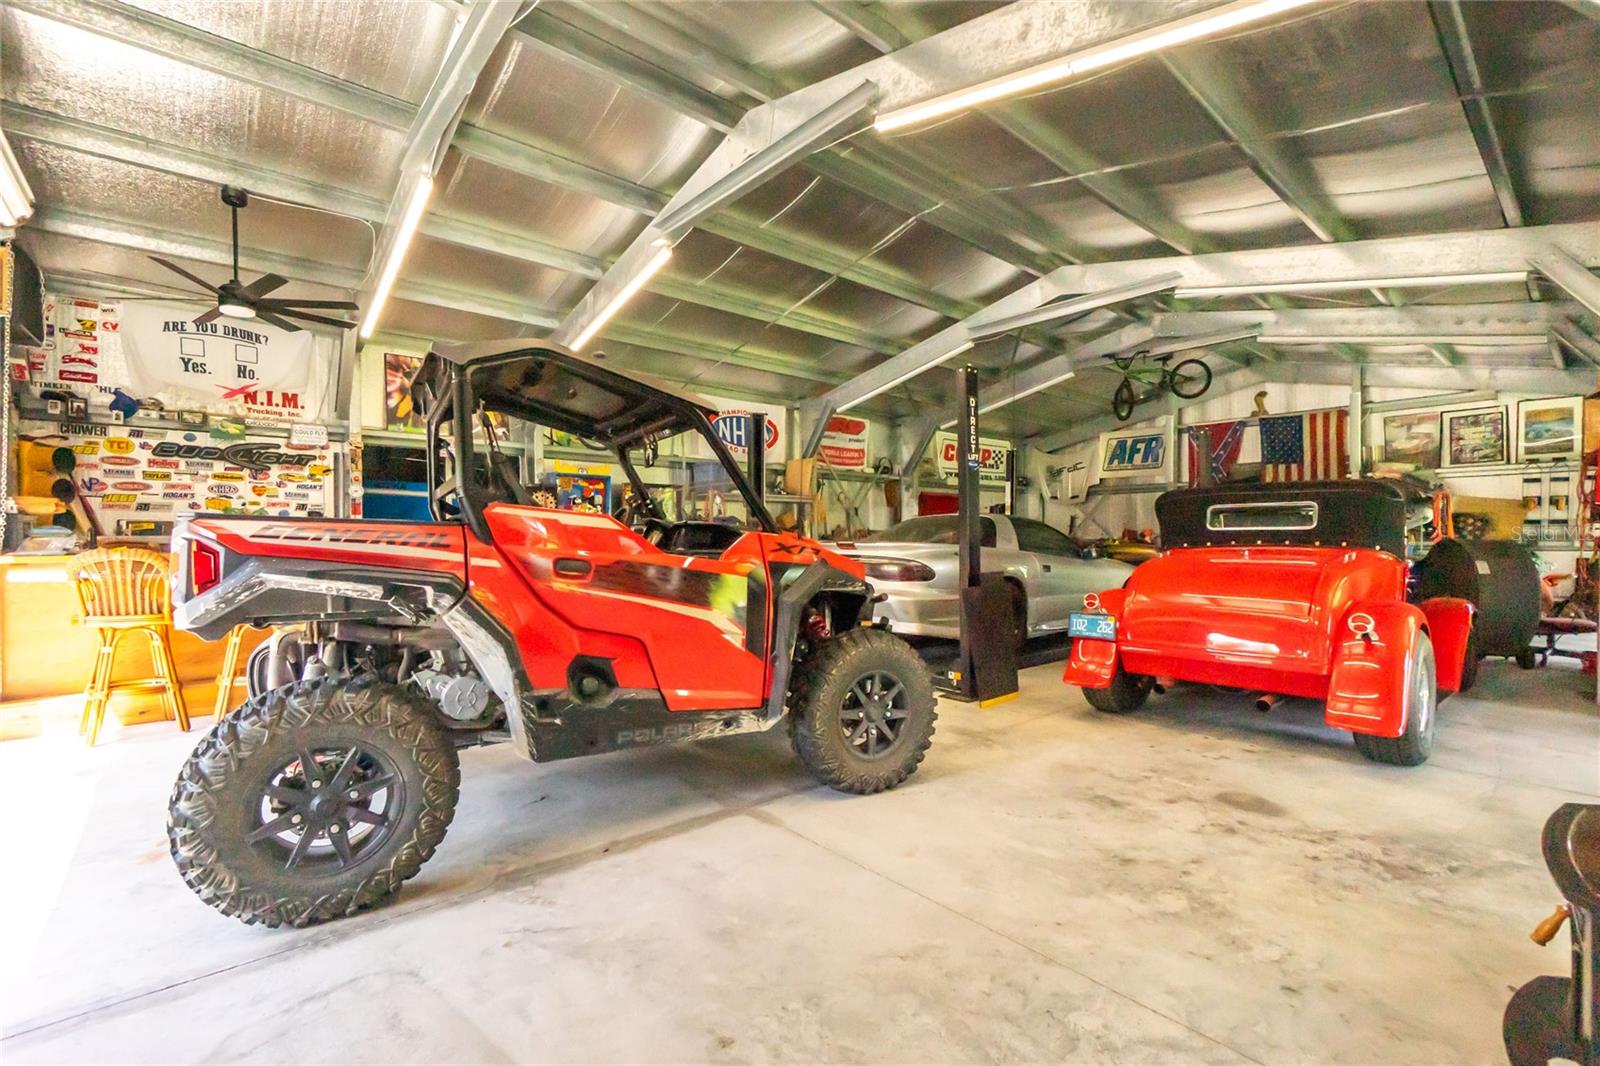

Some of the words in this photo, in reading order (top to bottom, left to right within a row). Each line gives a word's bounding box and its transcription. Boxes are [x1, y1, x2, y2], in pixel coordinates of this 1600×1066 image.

[162, 321, 187, 333] ARE
[195, 321, 218, 334] YOU
[223, 325, 269, 346] DRUNK?
[179, 357, 213, 375] Yes.
[236, 364, 260, 381] No.
[243, 390, 305, 410] N.I.M.
[60, 423, 107, 437] CROWER
[968, 397, 977, 453] DIRECT
[108, 439, 129, 450] TCI
[154, 443, 221, 459] BUD
[237, 450, 316, 466] LIGHT
[1107, 436, 1164, 466] AFR
[249, 525, 451, 548] GENERAL
